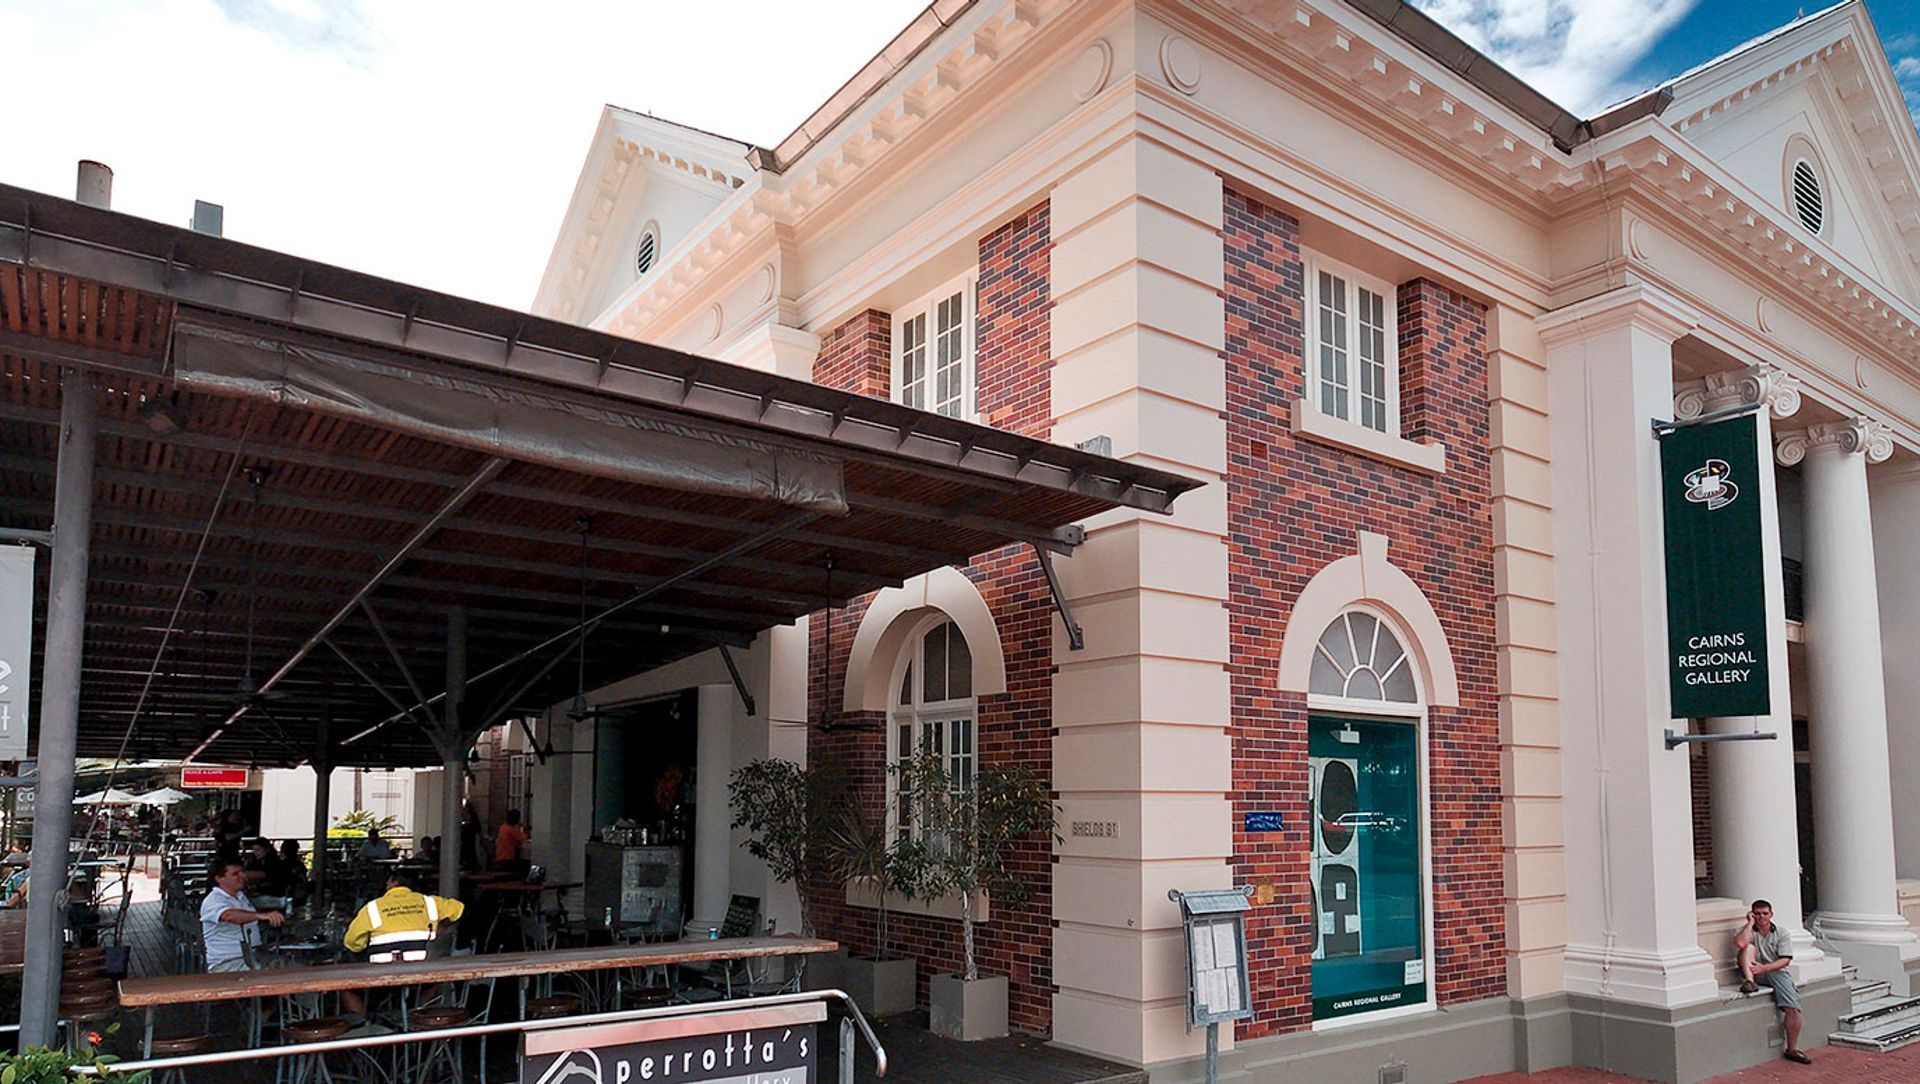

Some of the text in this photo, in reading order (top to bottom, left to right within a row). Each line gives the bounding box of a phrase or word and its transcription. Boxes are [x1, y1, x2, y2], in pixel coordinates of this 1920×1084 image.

[1688, 632, 1745, 649] CAIRNS
[1678, 651, 1757, 668] REGIONAL
[1685, 669, 1750, 685] GALLERY
[1072, 821, 1104, 837] SHIELDS
[1332, 992, 1402, 1010] CAIRNS REGIONAL GALLERY
[616, 1029, 808, 1084] perrotta's
